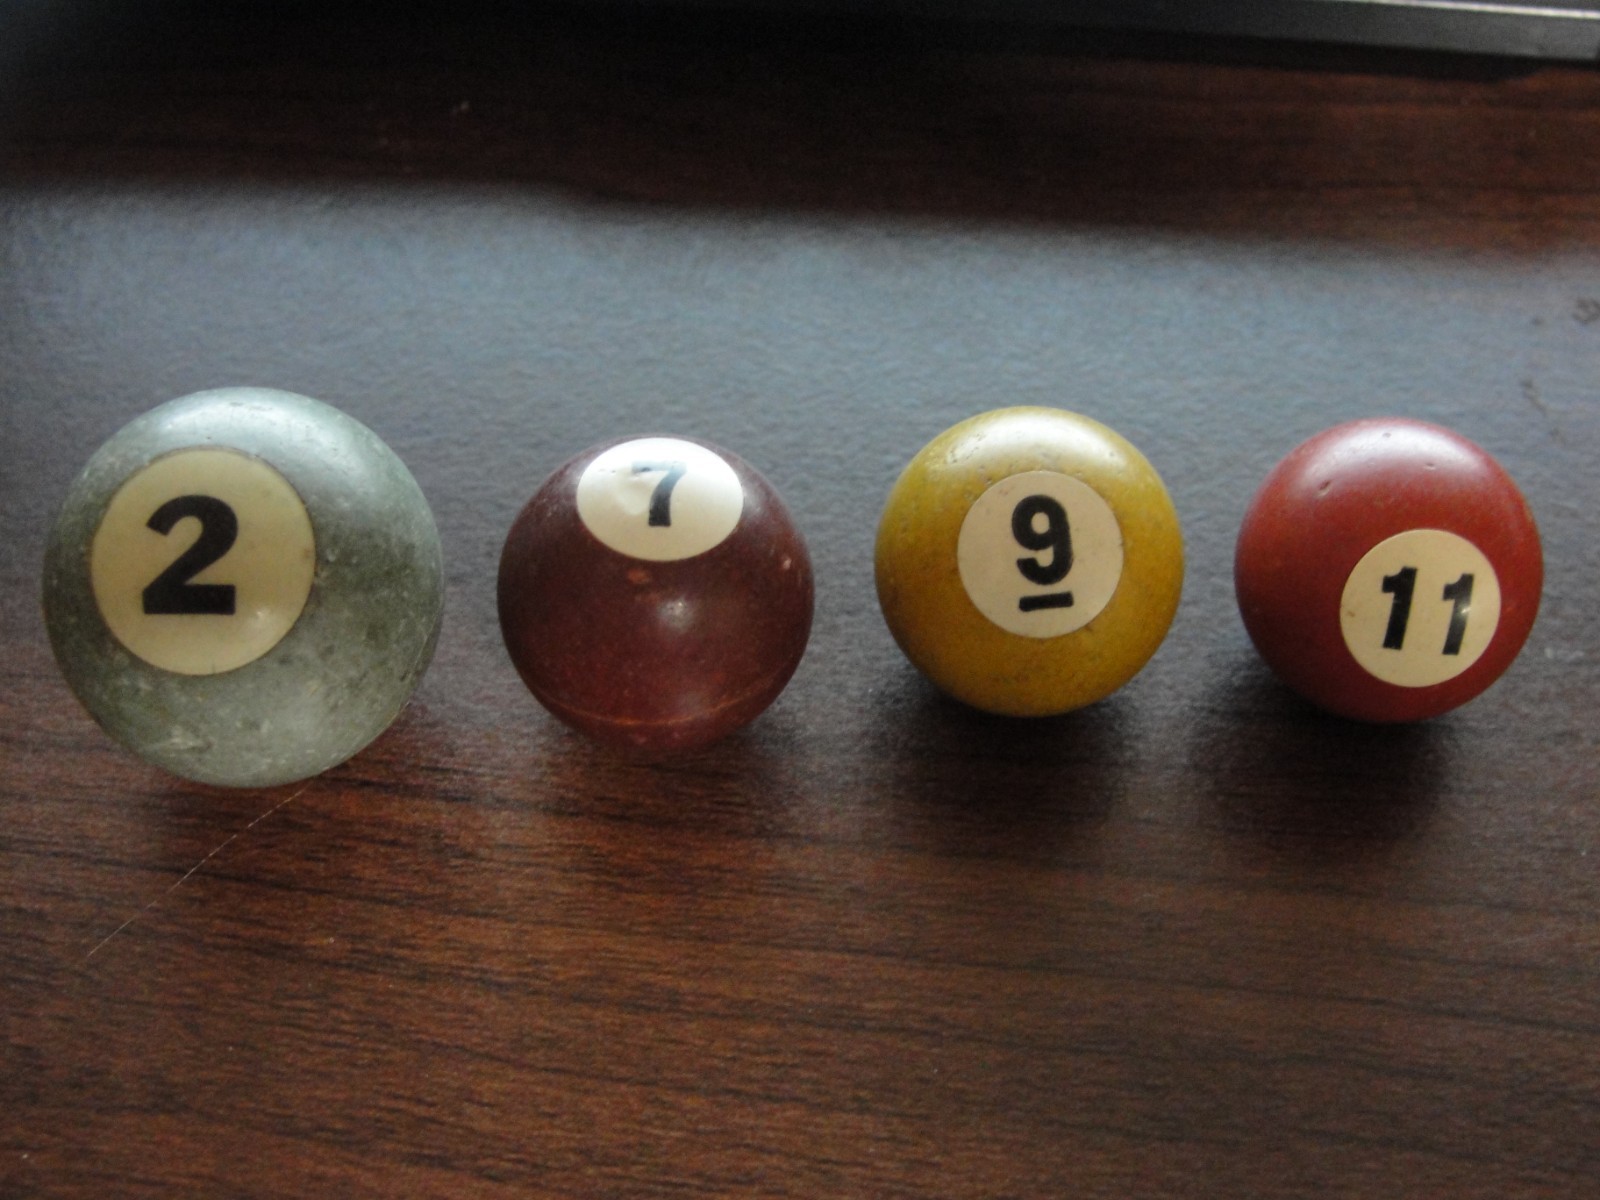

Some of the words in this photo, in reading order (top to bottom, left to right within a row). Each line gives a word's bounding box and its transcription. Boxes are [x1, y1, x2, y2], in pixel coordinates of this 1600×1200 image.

[631, 460, 687, 527] 7
[141, 494, 239, 616] 2
[1011, 495, 1074, 586] 9
[1381, 566, 1475, 656] 11
